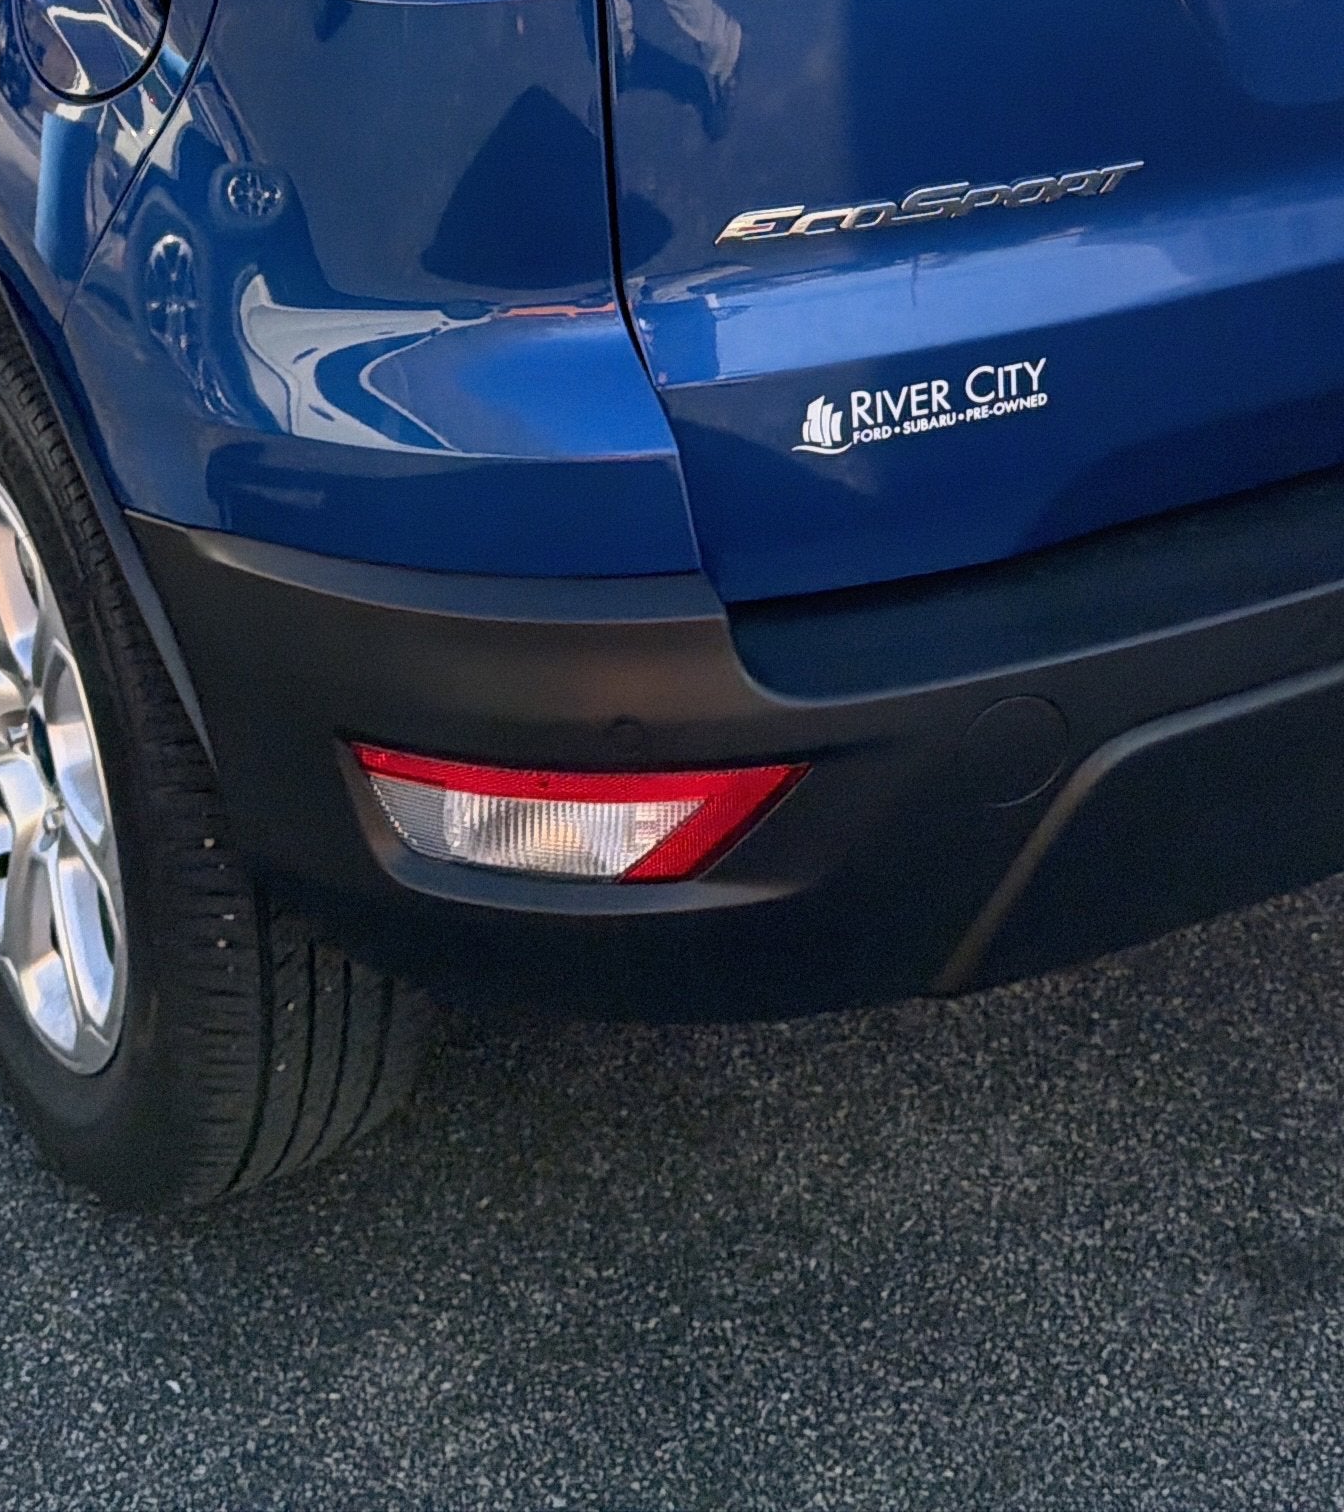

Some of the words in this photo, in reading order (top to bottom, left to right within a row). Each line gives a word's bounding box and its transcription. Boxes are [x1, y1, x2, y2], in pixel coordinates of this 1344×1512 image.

[850, 379, 952, 428] RIVER
[964, 357, 1047, 404] CITY
[852, 425, 893, 445] FORD
[902, 411, 957, 435] SUBARU
[965, 392, 1048, 422] PRE-OWNED
